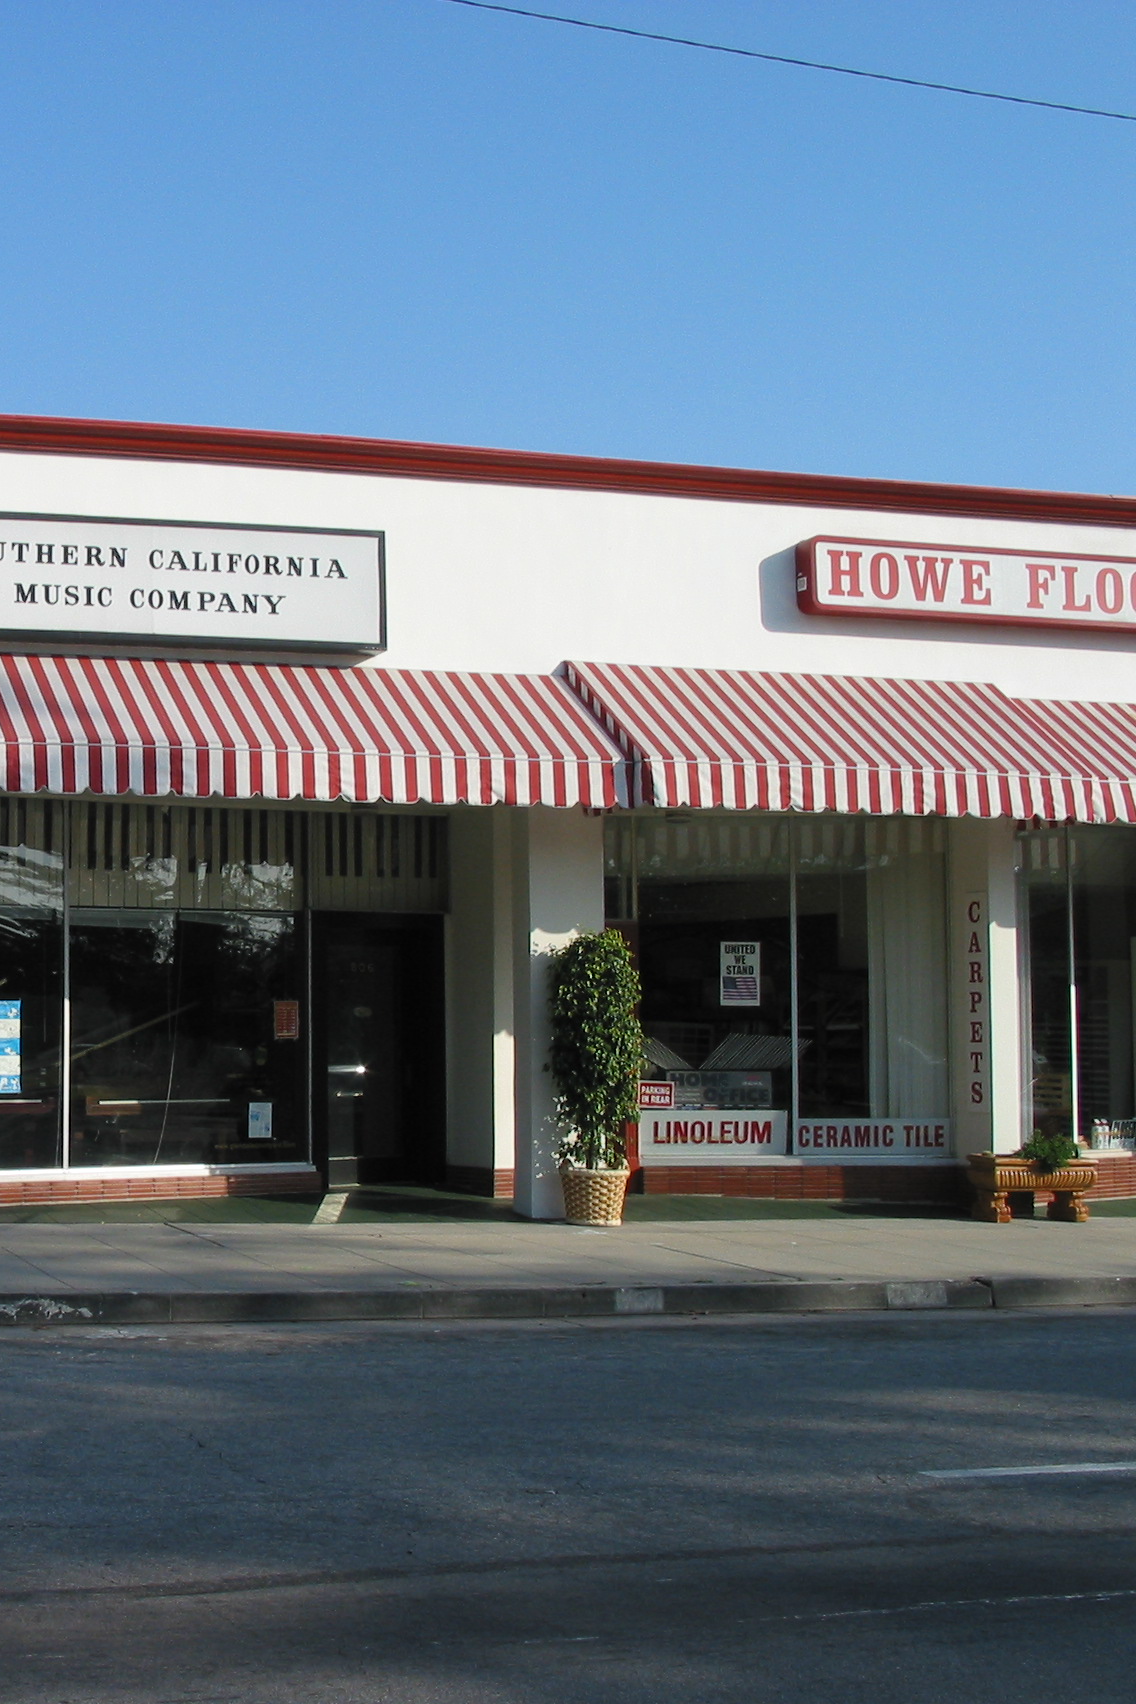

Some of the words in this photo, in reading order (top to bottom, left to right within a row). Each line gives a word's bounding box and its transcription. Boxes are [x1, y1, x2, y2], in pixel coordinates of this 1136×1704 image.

[148, 549, 349, 580] CALIFORNIA
[826, 549, 992, 606] HOWE
[14, 582, 114, 608] MUSIC
[129, 588, 287, 615] COMPANY
[724, 944, 756, 955] UNITED
[734, 955, 746, 965] WE
[726, 965, 755, 975] STAND
[968, 901, 984, 1104] CARPETS
[641, 1086, 671, 1095] PARKING
[641, 1095, 651, 1104] IN
[651, 1095, 671, 1104] REAR
[653, 1120, 772, 1144] LINOLEUM
[797, 1125, 894, 1148] CERAMIC
[903, 1125, 945, 1148] TILE
